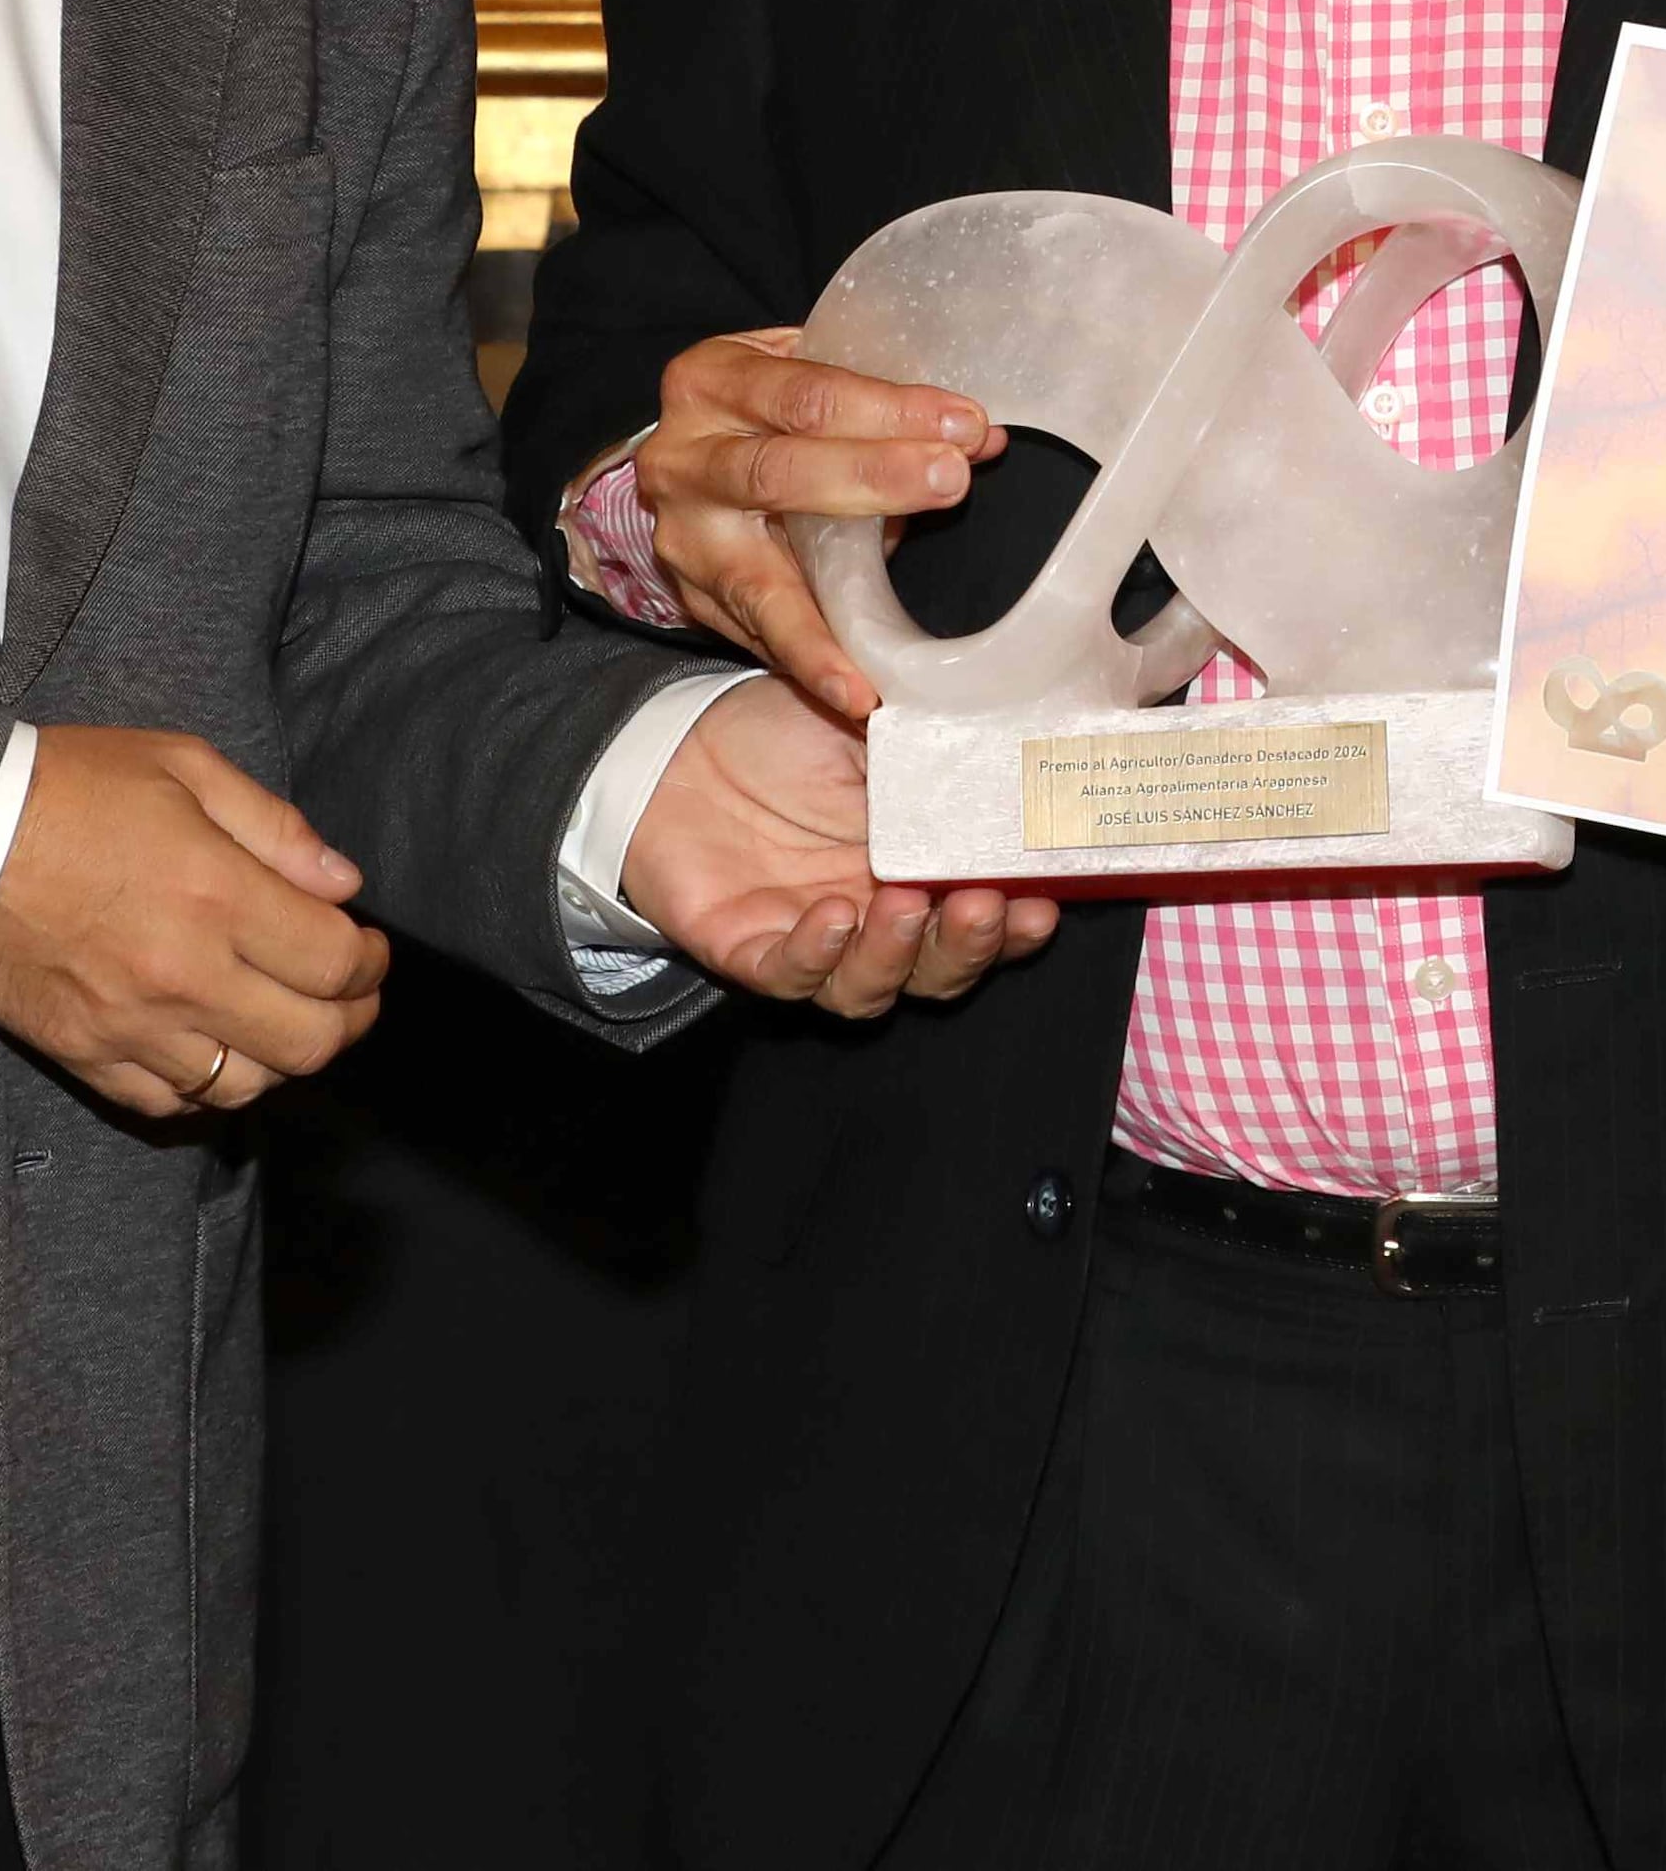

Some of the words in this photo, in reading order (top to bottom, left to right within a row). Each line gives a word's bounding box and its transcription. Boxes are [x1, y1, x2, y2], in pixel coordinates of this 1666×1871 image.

[1039, 760, 1088, 773] Premio
[1093, 758, 1105, 771] al
[1109, 752, 1252, 772] Agricultor/Ganadero
[1257, 748, 1329, 762] Destacado
[1334, 745, 1367, 758] 2024
[1081, 784, 1132, 797] Alianza
[1135, 780, 1248, 797] Agroalimentaria
[1253, 776, 1328, 791] Aragonesa
[1096, 810, 1132, 826] JOSÉ
[1137, 811, 1169, 824] LUIS
[1173, 806, 1241, 822] SÁNCHEZ
[1246, 803, 1315, 818] SÁNCHEZ
